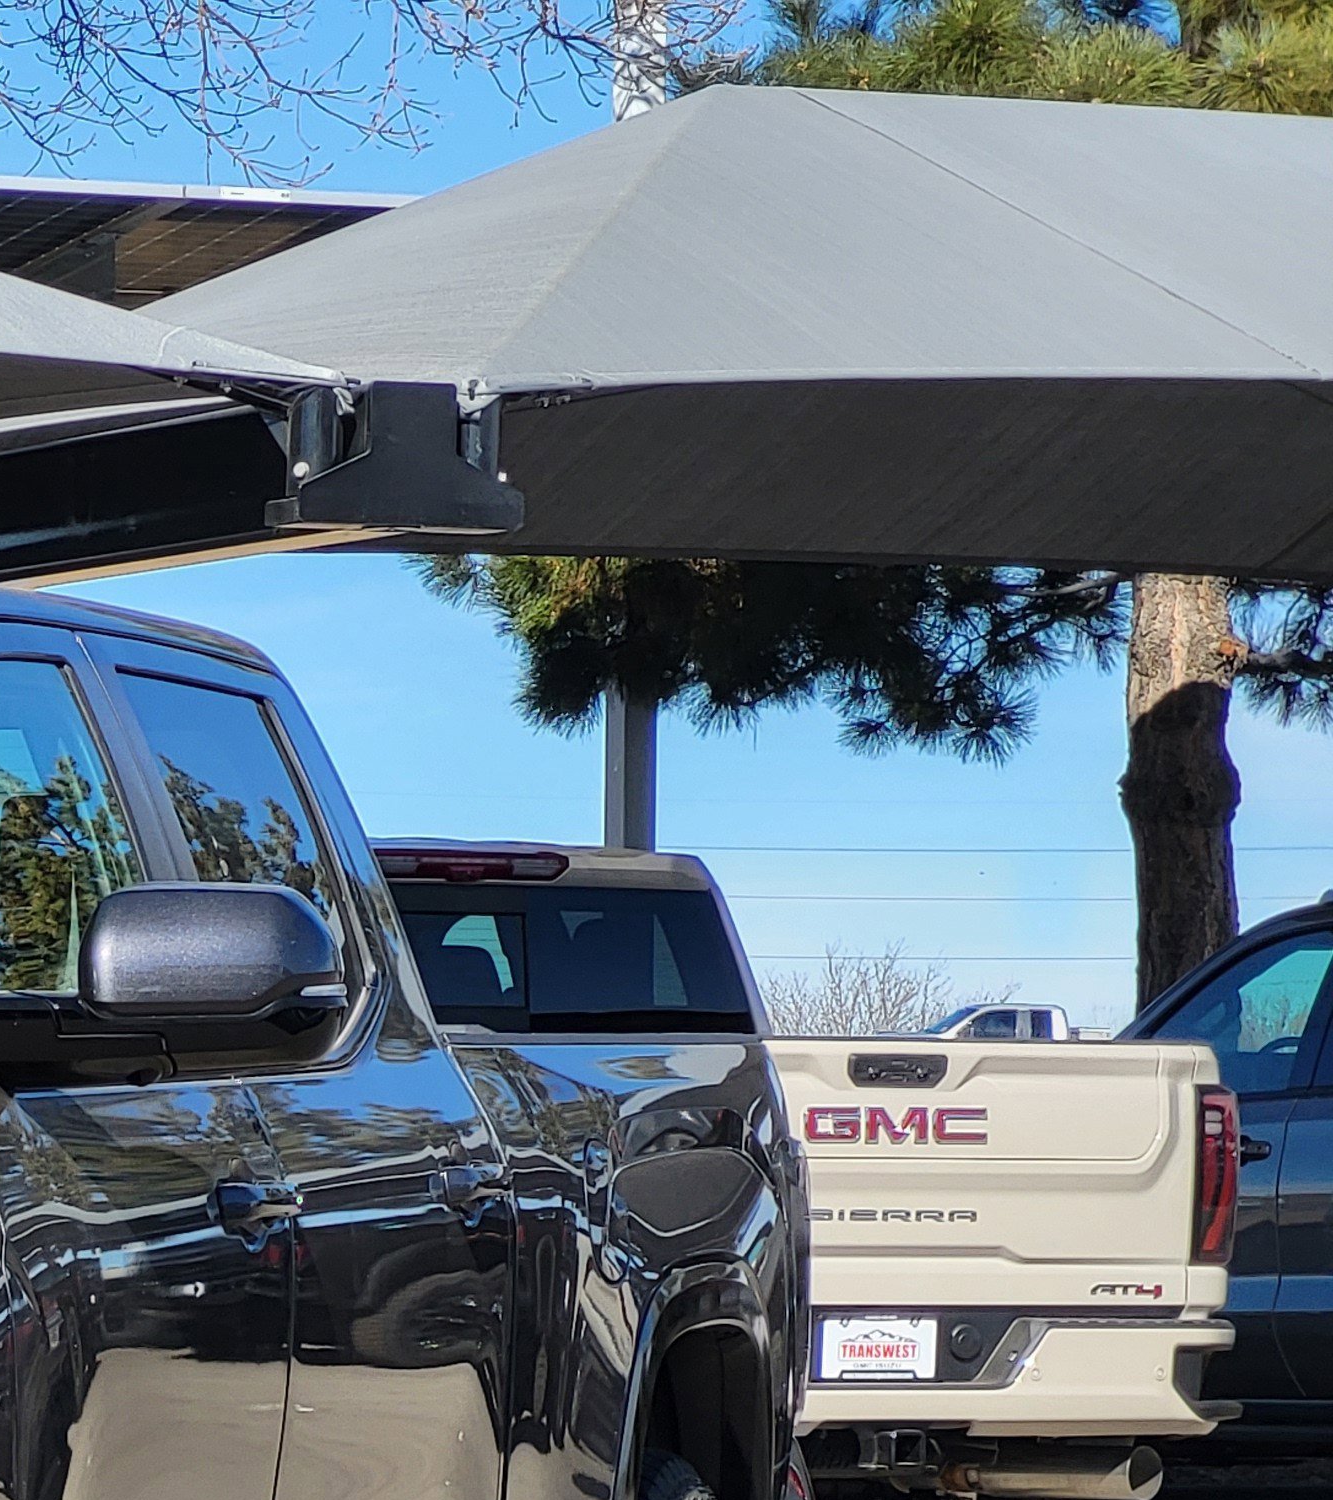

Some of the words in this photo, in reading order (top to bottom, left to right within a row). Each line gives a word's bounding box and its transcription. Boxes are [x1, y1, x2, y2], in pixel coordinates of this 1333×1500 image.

[804, 1106, 988, 1145] GMC
[809, 1208, 978, 1223] SIERRA
[1090, 1283, 1162, 1299] AT4
[841, 1344, 917, 1358] TRANSWEST
